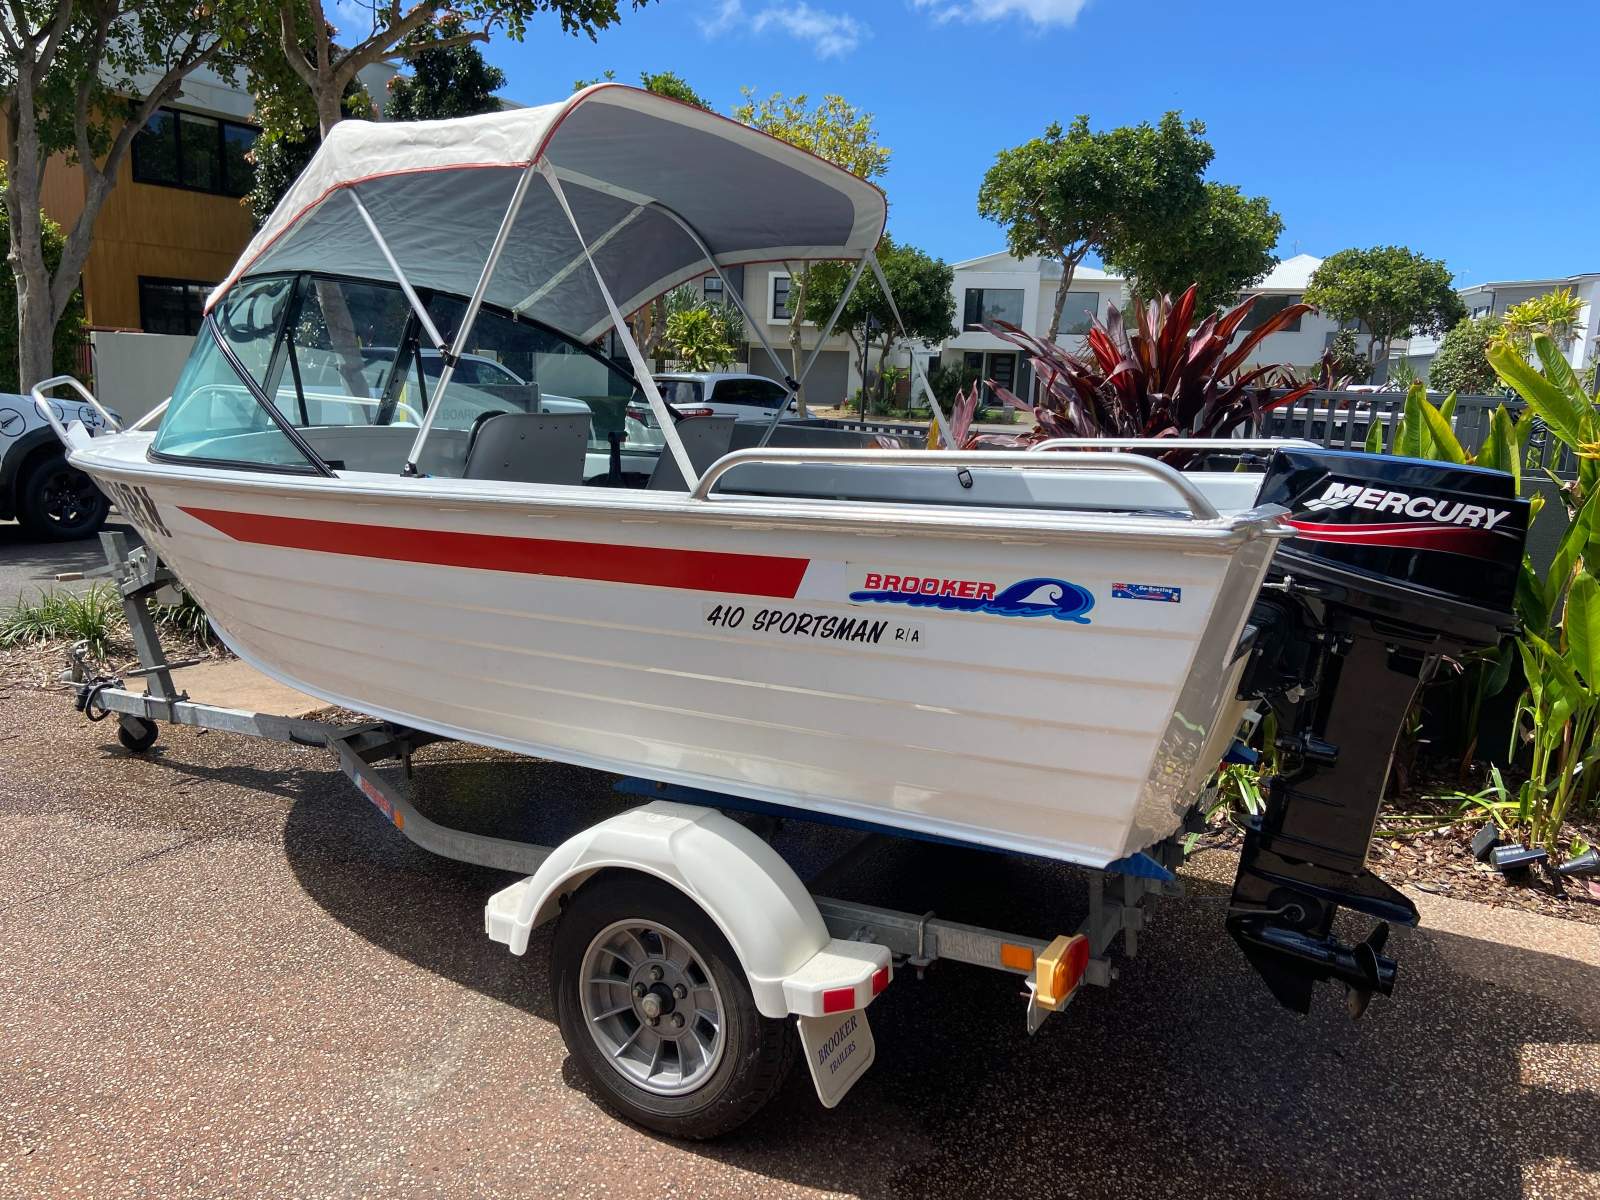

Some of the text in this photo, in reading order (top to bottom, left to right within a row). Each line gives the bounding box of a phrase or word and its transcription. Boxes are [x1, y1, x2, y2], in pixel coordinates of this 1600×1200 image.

[1303, 482, 1511, 530] MERCURY
[864, 573, 997, 601] BROOKER
[706, 605, 920, 645] 410 SPORTSMAN R/A
[818, 1015, 858, 1065] BROOKER
[830, 1040, 856, 1074] TRAILERS
